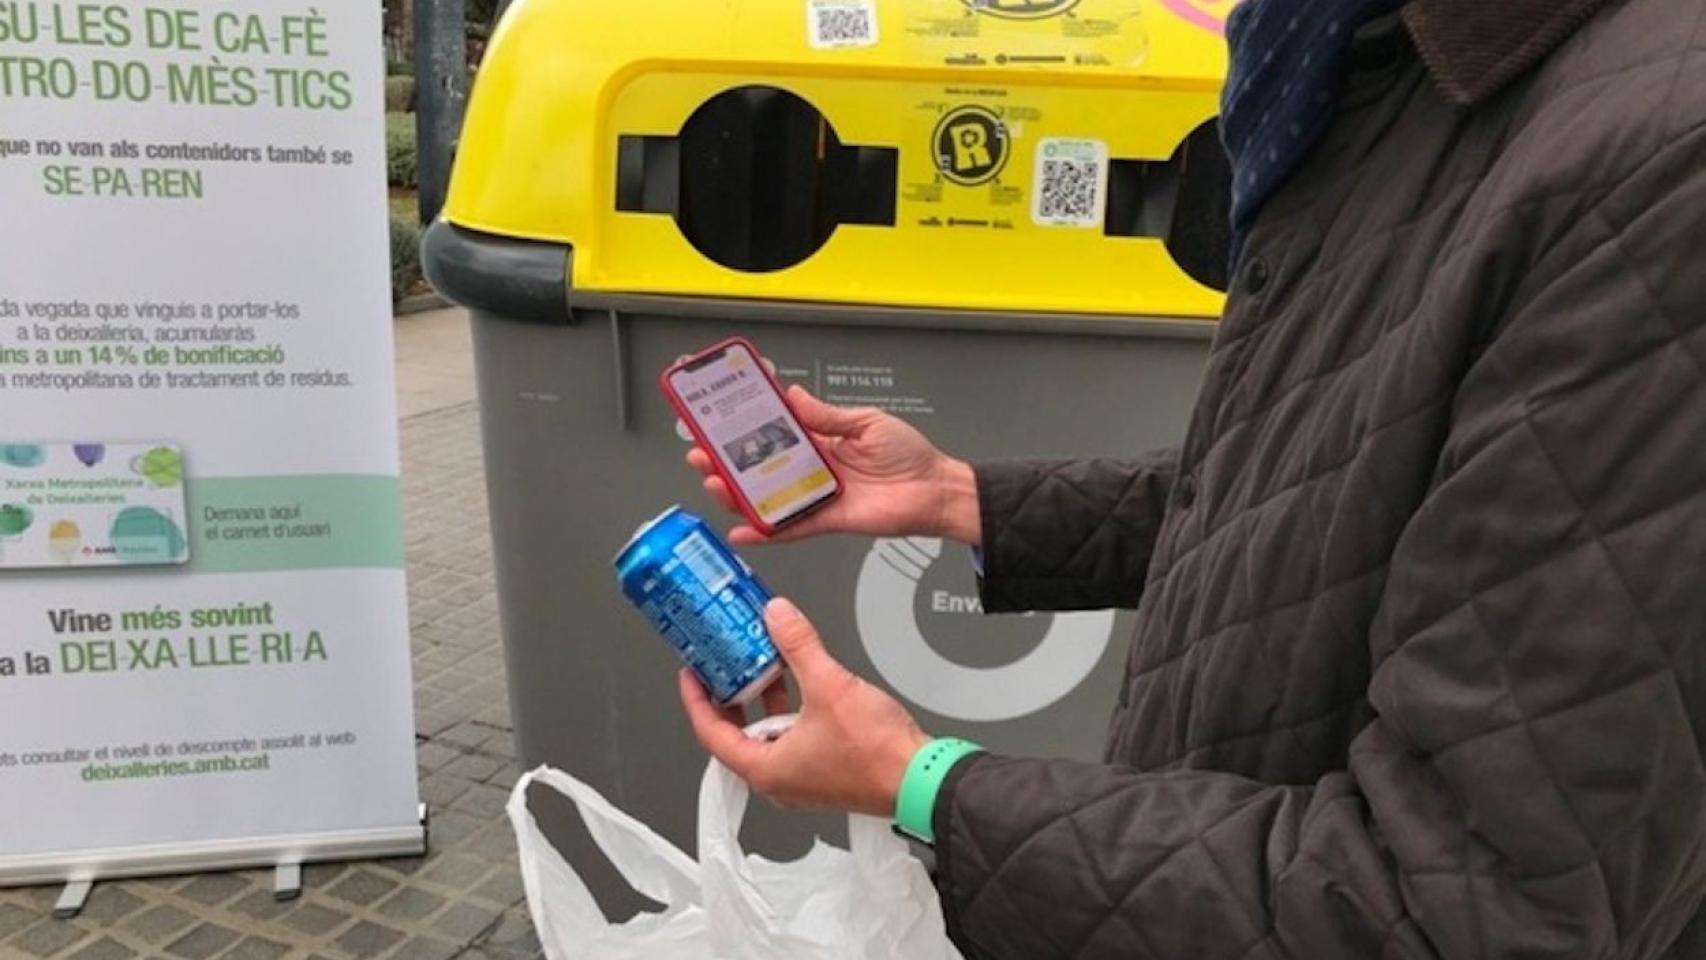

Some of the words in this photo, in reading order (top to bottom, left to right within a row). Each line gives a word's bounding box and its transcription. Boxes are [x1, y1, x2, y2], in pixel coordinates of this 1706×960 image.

[145, 8, 201, 50] DE
[214, 8, 329, 56] CA-FÈ
[0, 56, 352, 110] TRO-DO-MÈS-TICS
[36, 140, 61, 156] no
[67, 141, 103, 158] van
[110, 140, 139, 158] als
[145, 142, 262, 162] contenidors
[267, 145, 326, 164] també
[331, 149, 352, 165] se
[43, 165, 203, 198] SE-PA-REN
[25, 300, 90, 321] vegada
[95, 302, 128, 320] que
[135, 301, 195, 321] vinguis
[201, 304, 212, 318] a
[217, 301, 299, 321] portar-los
[17, 326, 28, 340] a
[33, 324, 50, 340] la
[154, 324, 255, 342] acumularàs
[35, 349, 48, 364] a
[55, 349, 82, 364] un
[144, 346, 169, 364] de
[175, 344, 285, 364] bonificació
[12, 370, 133, 391] metropolitana
[138, 371, 160, 388] de
[166, 371, 259, 388] tractament
[264, 371, 285, 387] de
[291, 370, 352, 387] residus.
[204, 506, 266, 522] Demana
[205, 525, 218, 540] el
[48, 609, 112, 633] Vine
[121, 604, 181, 630] més
[190, 601, 273, 629] sovint
[0, 656, 15, 675] a
[25, 651, 50, 675] la
[60, 630, 327, 674] DEI-XA-LLE-RI-A
[154, 743, 173, 756] de
[325, 731, 356, 744] web
[81, 752, 270, 781] deixalleries.amb.cat
